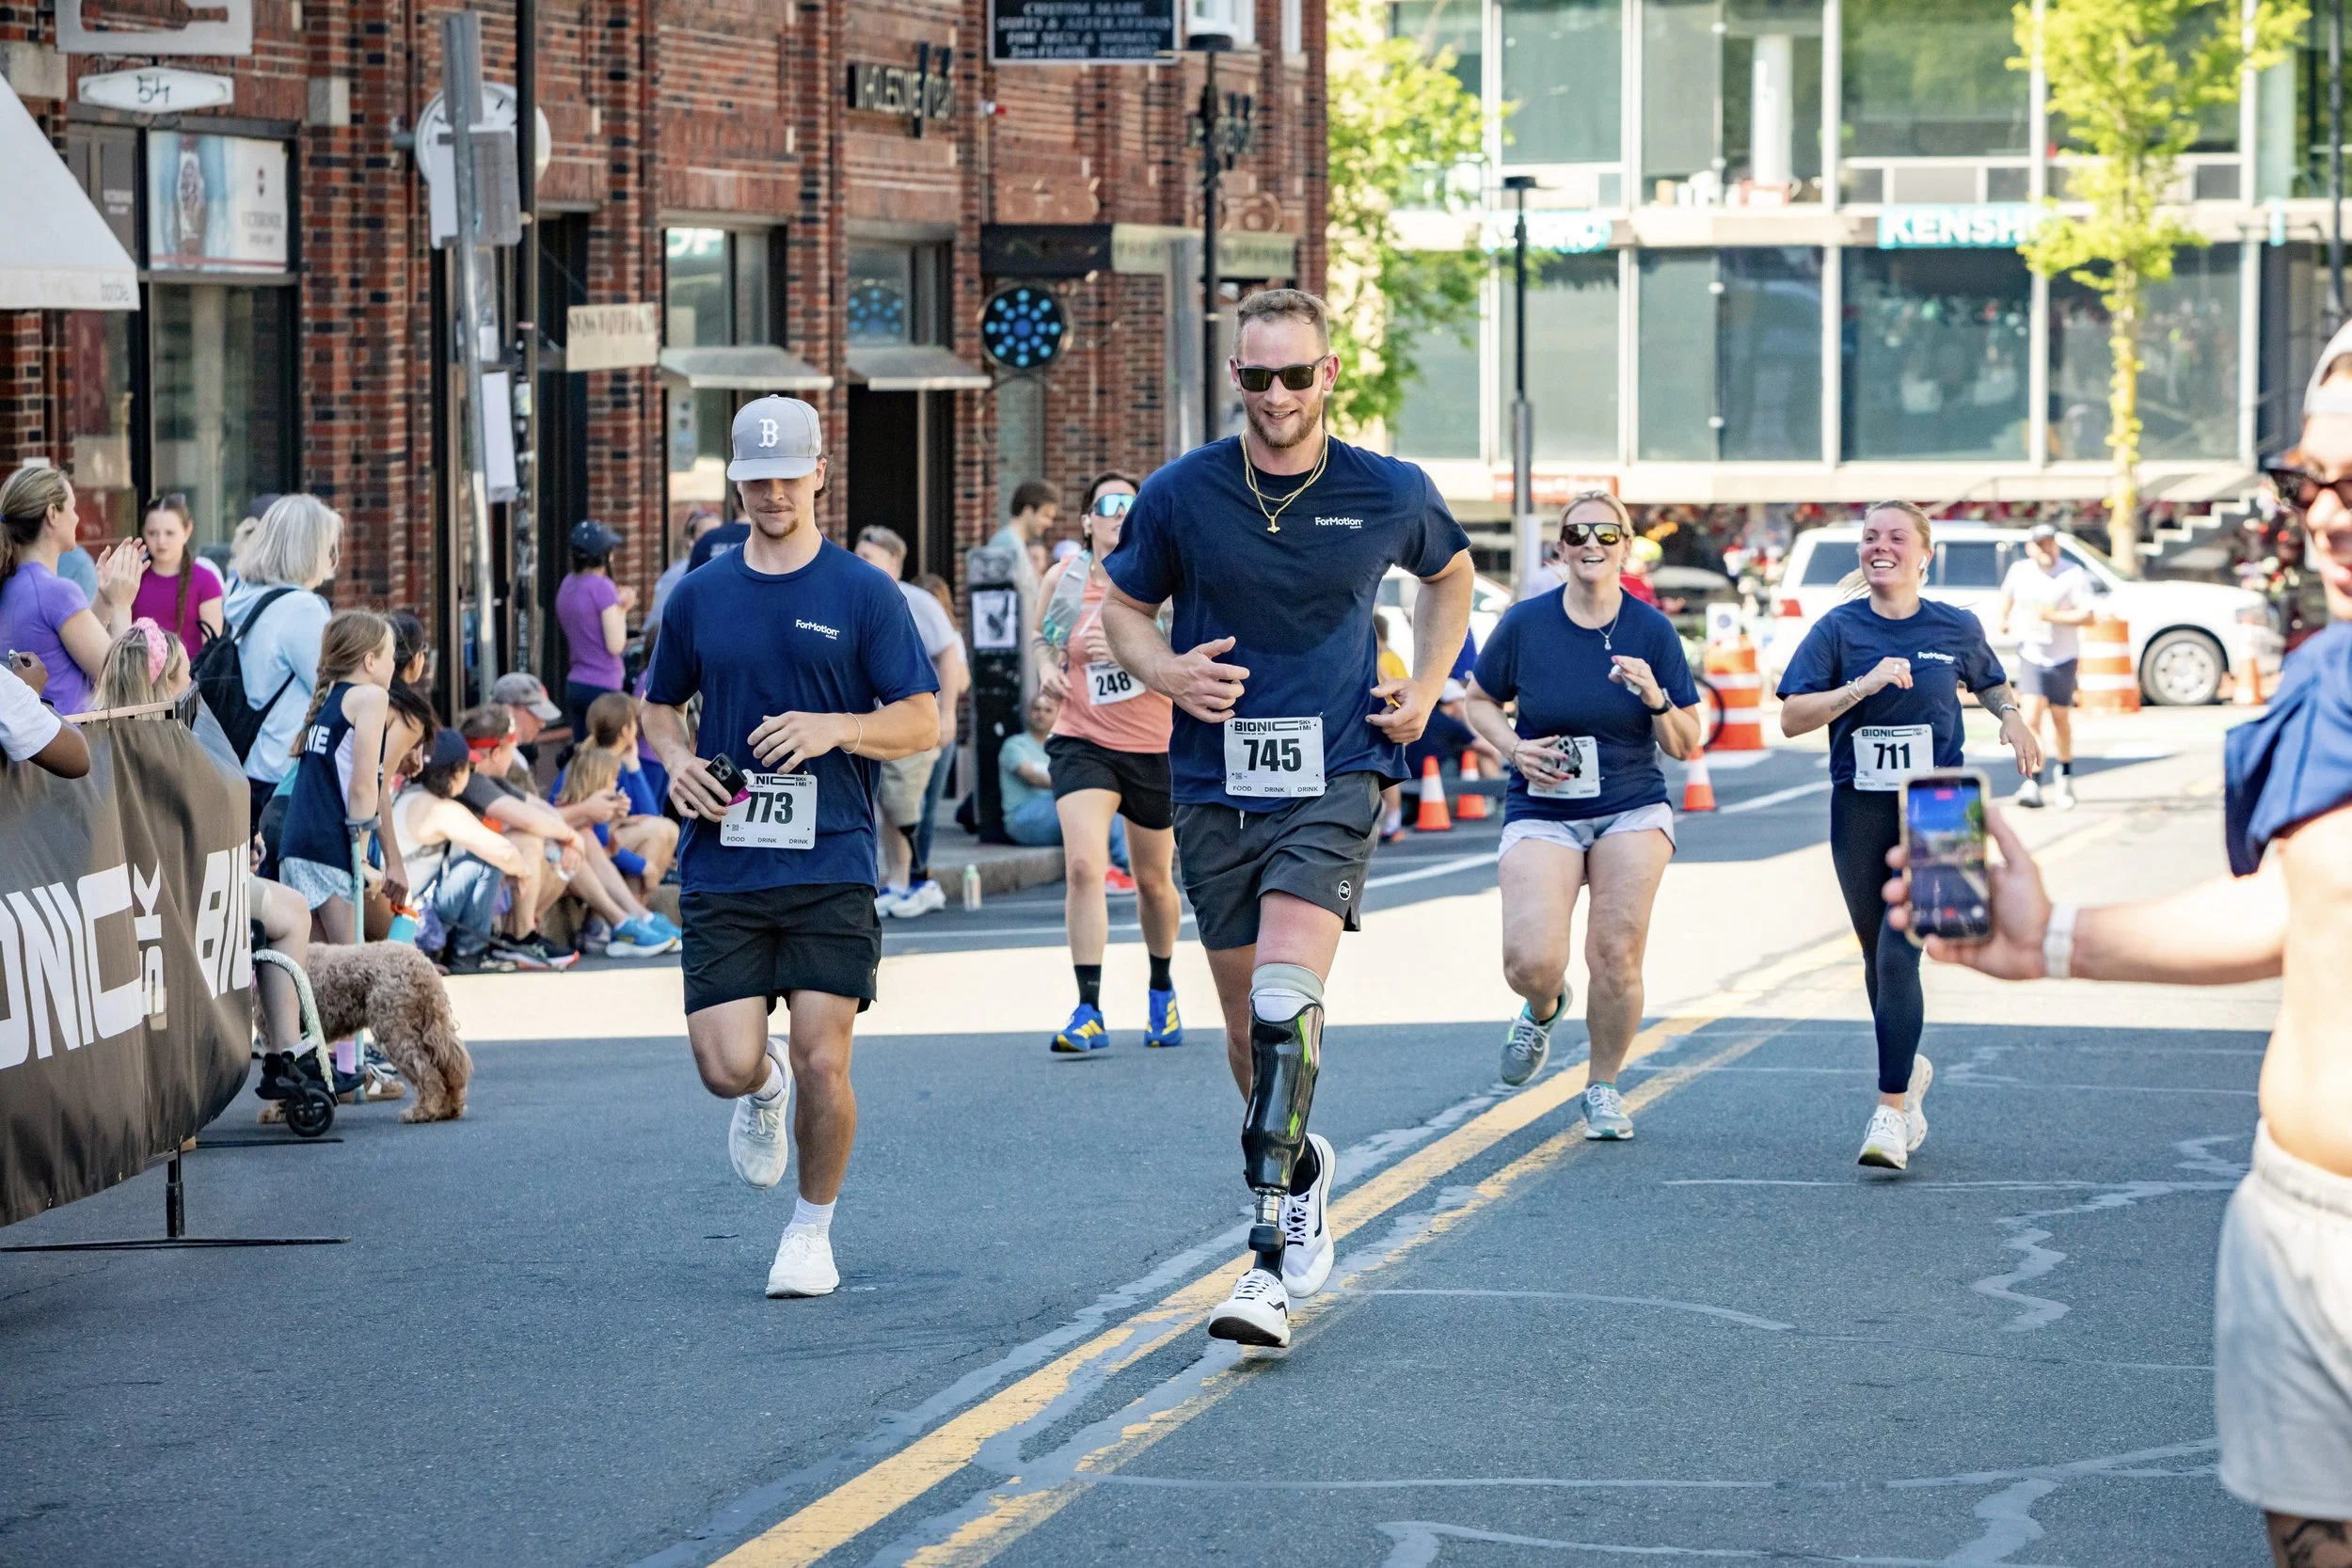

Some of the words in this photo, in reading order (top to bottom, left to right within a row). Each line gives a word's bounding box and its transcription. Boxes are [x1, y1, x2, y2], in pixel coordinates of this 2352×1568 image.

[136, 74, 170, 104] 54
[1883, 207, 2043, 245] KENSH
[758, 418, 779, 448] B
[1314, 516, 1363, 526] ForMotion
[795, 619, 839, 636] ForMotion
[1096, 671, 1132, 696] 248
[1234, 720, 1299, 732] BIONIC
[1861, 728, 1914, 737] BIONIC
[1243, 738, 1302, 772] 745
[1873, 742, 1911, 769] 711
[745, 791, 794, 825] 773
